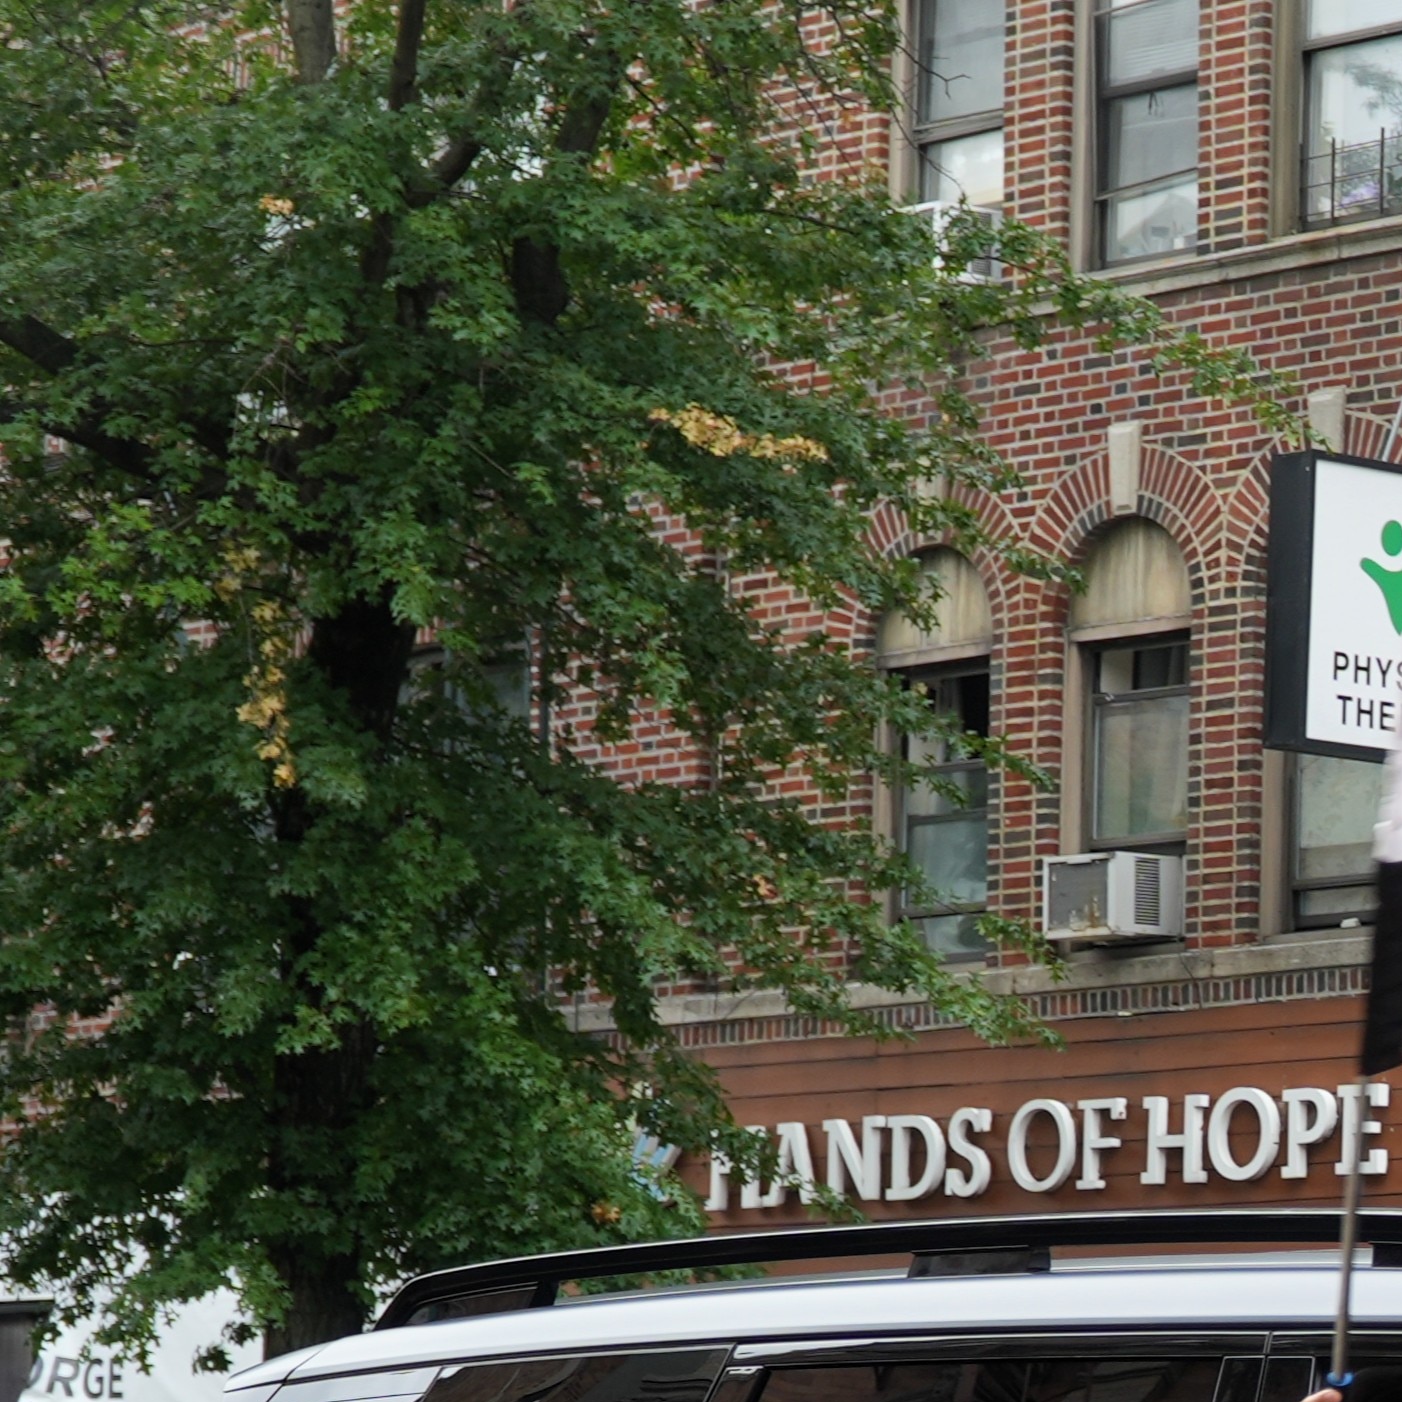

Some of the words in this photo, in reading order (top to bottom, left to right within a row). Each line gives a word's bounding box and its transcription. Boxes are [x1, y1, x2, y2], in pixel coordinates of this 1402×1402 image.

[1337, 694, 1397, 732] THE
[706, 1106, 992, 1213] HANDS
[1007, 1095, 1127, 1193] OF
[1140, 1082, 1389, 1185] HOPE
